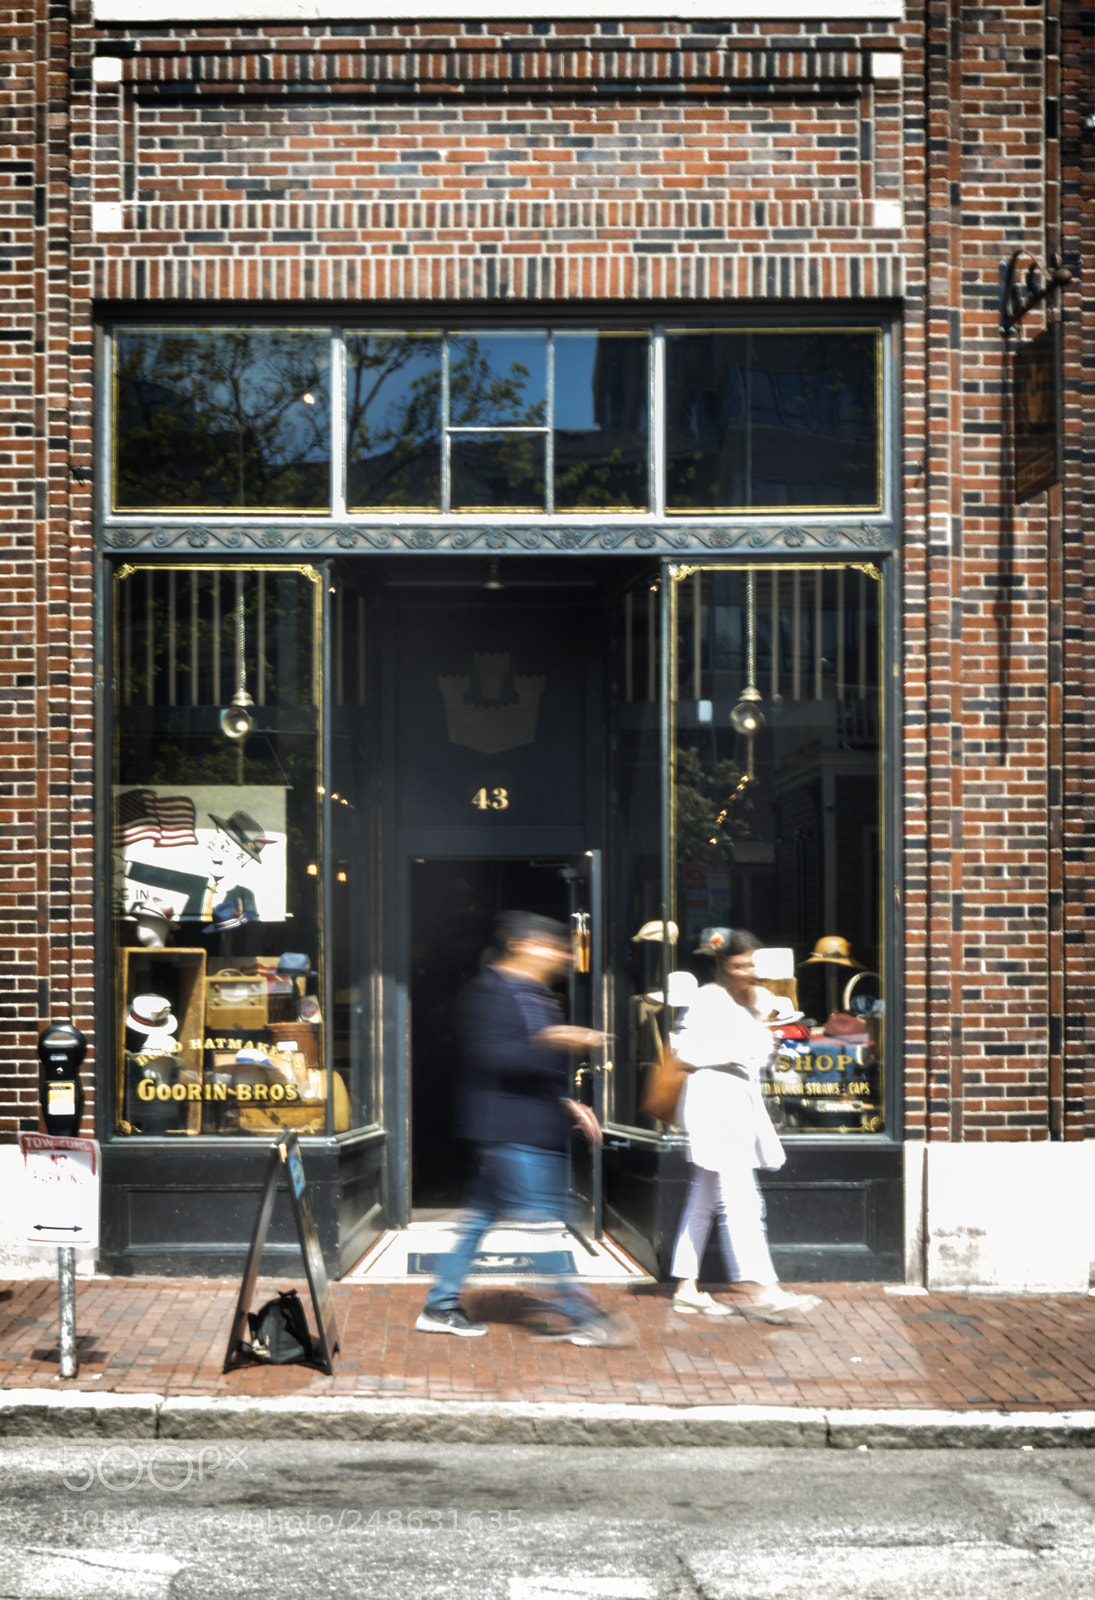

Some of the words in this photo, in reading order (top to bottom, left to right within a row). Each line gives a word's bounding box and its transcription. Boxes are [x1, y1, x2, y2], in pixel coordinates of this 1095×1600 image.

[471, 787, 509, 810] 43
[189, 1038, 304, 1070] HATMAKERS
[775, 1055, 853, 1072] SHOP
[137, 1078, 228, 1101] GOORIN
[236, 1083, 298, 1101] BROS
[805, 1082, 841, 1096] STRAWS
[848, 1082, 871, 1096] CAPS
